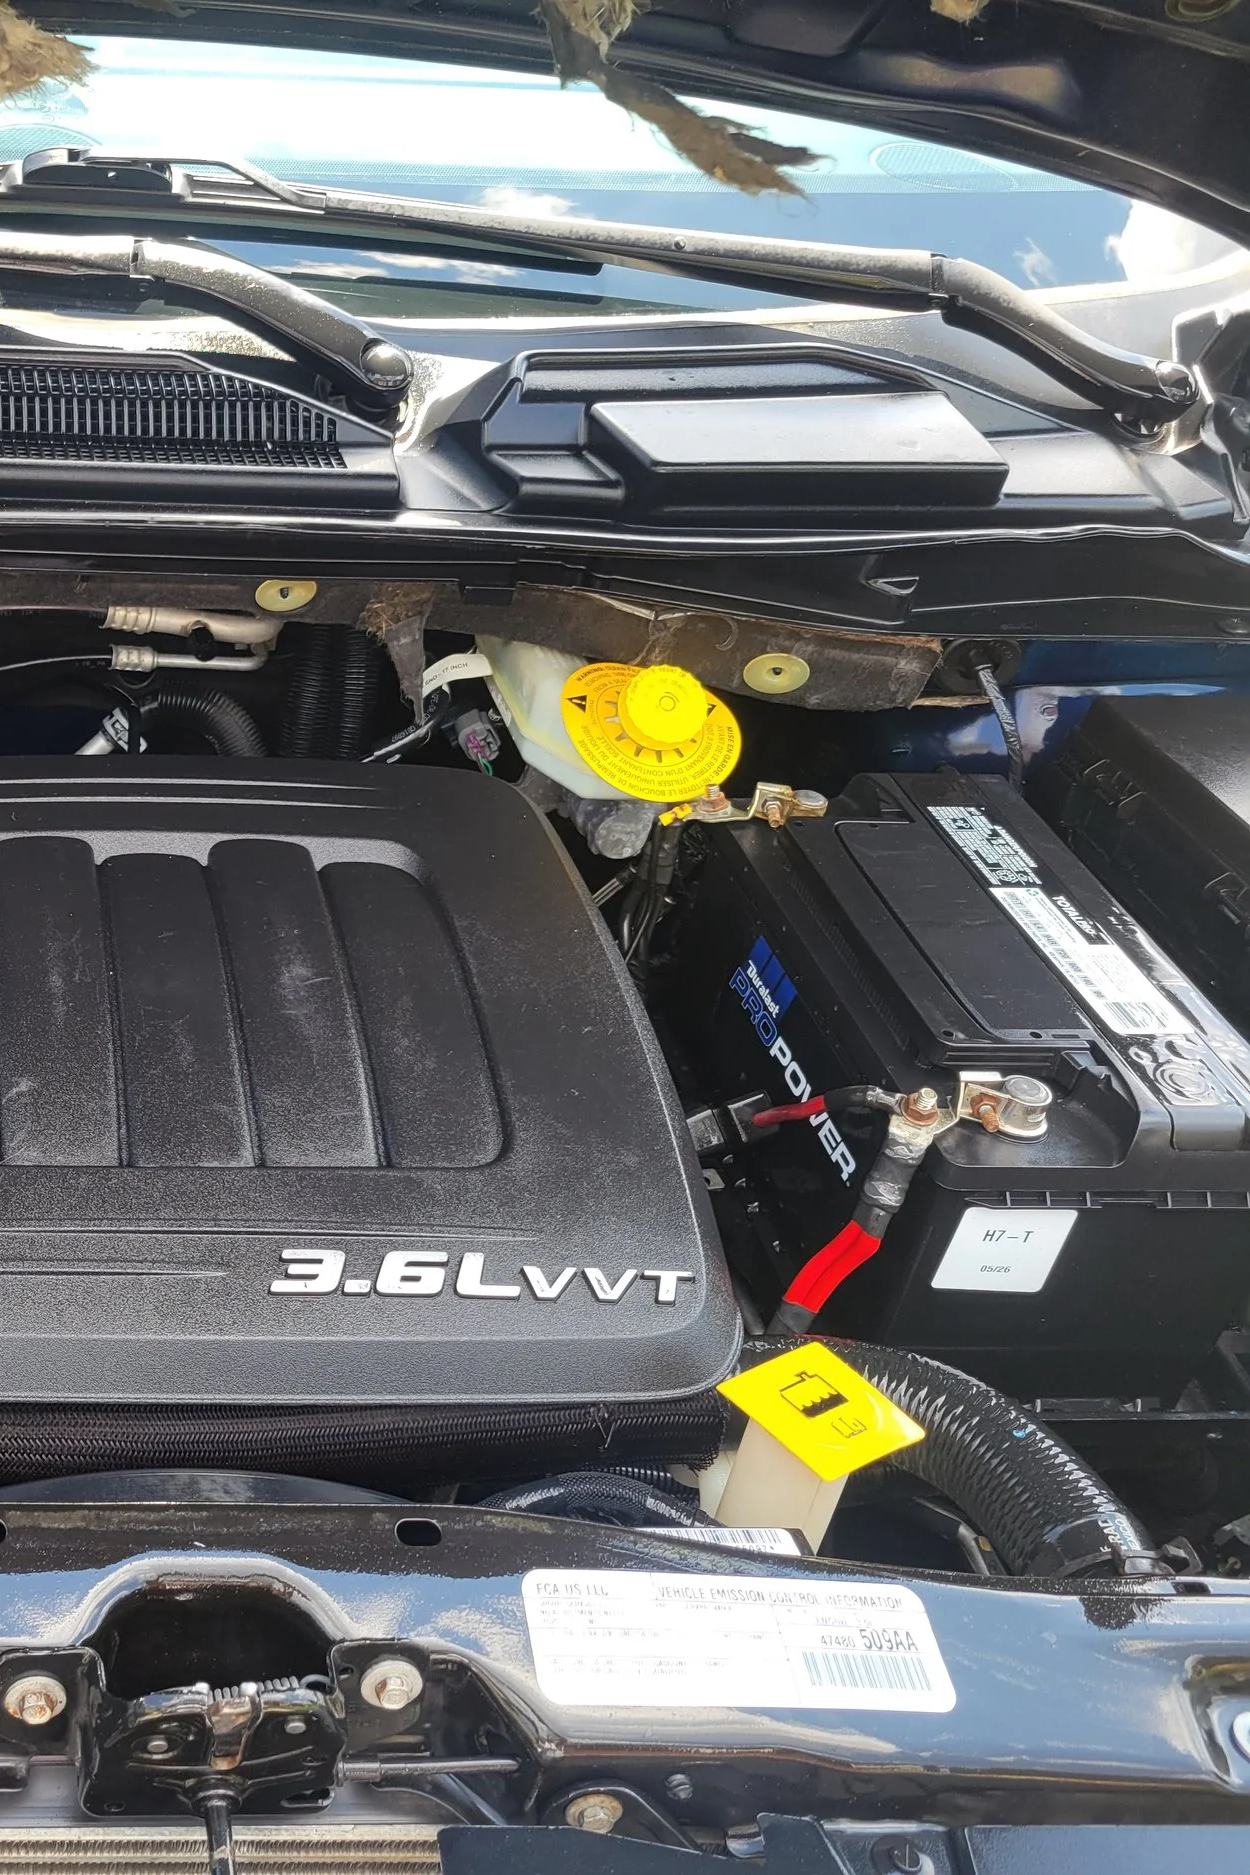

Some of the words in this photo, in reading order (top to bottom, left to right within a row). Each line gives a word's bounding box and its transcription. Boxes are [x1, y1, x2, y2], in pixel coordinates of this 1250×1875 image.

[726, 726, 734, 742] MISE
[598, 750, 610, 762] DU
[684, 742, 712, 772] PROVENANT
[726, 744, 734, 754] EN
[578, 738, 616, 780] REMPLISSAGE
[618, 758, 664, 776] CONTENANT
[608, 760, 656, 786] UNIQUEMENT
[666, 768, 684, 776] D'UN
[618, 777, 628, 786] DE
[628, 782, 666, 796] BOUCHON
[658, 776, 688, 786] UTILISER
[746, 960, 780, 1018] Duralast
[269, 1249, 521, 1300] 3.6L
[521, 1265, 696, 1305] VVT
[980, 1265, 1012, 1274] 05/26
[536, 1582, 560, 1596] FCA
[564, 1584, 582, 1596] US
[657, 1586, 706, 1600] VEHICLE
[710, 1588, 765, 1602] EMISSION
[769, 1591, 822, 1604] CONTROL
[825, 1595, 902, 1609] INFORMATION
[820, 1634, 856, 1648] 47480
[858, 1628, 920, 1652] 509AA
